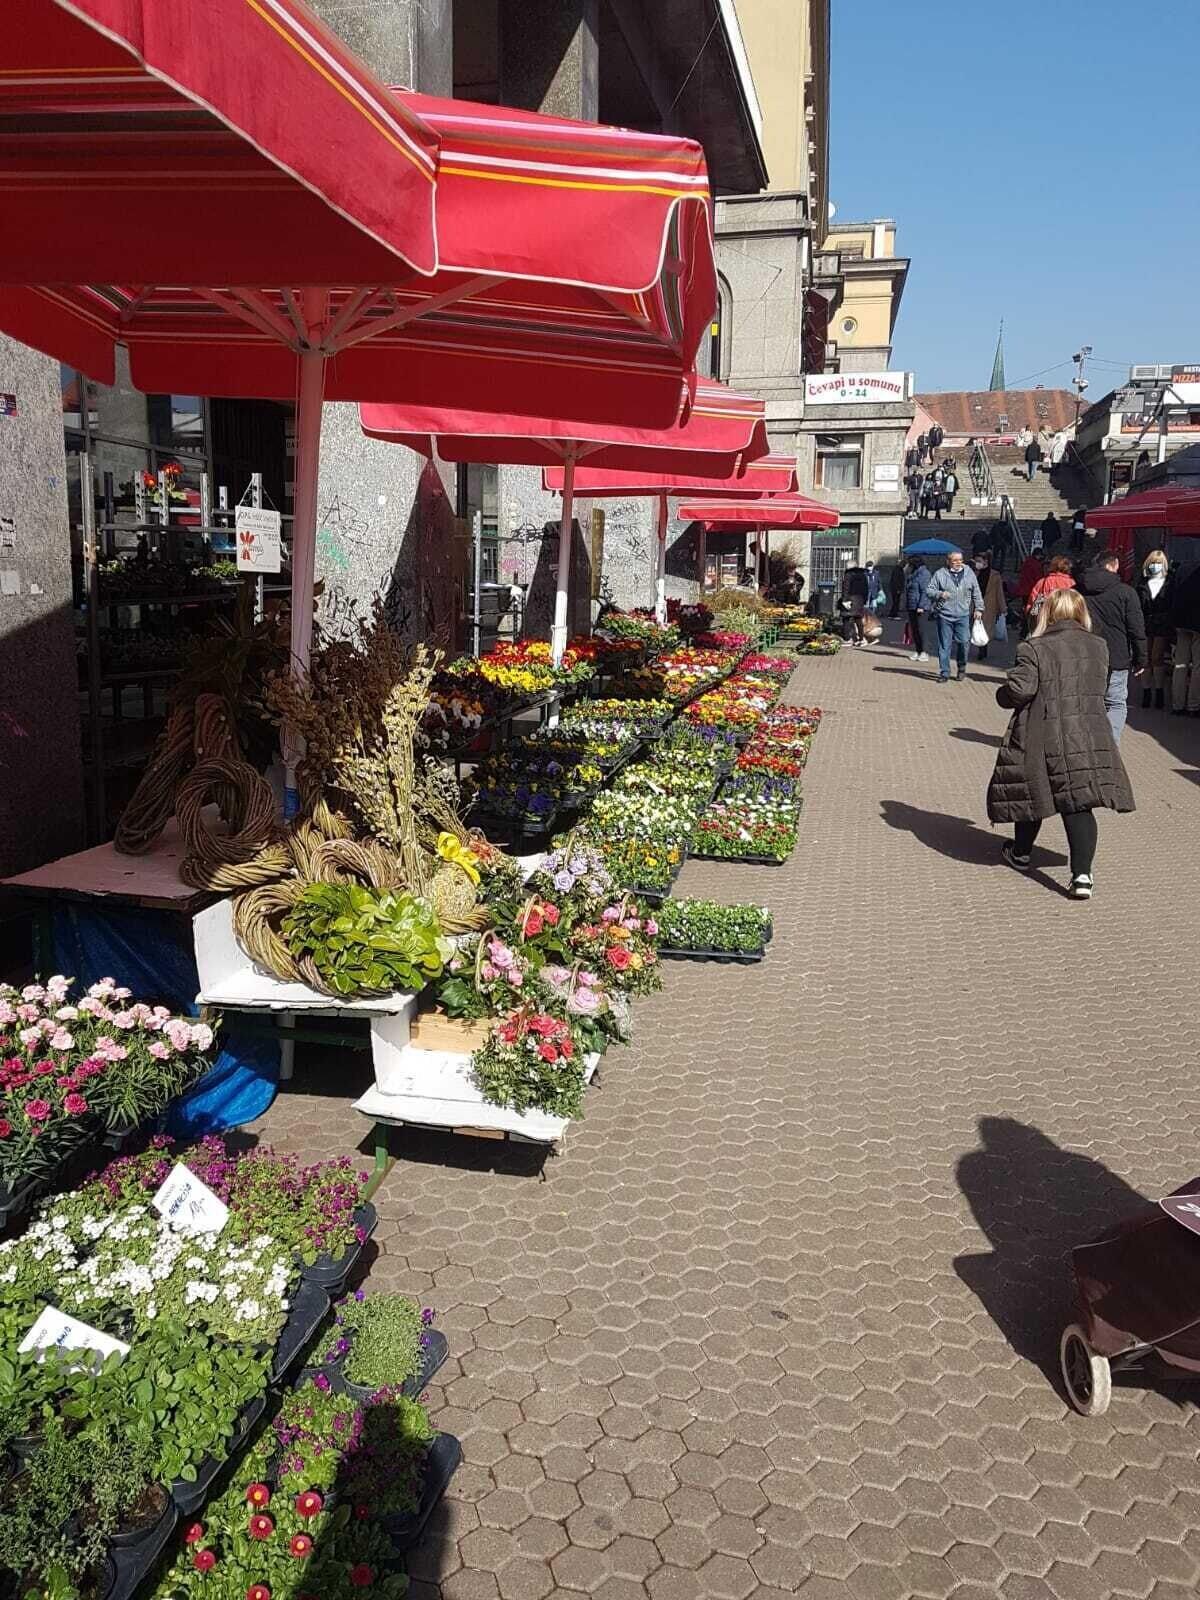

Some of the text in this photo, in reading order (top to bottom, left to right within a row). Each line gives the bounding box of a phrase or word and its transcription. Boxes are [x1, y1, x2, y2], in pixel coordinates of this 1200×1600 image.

[808, 377, 901, 396] Čevapi u somunu
